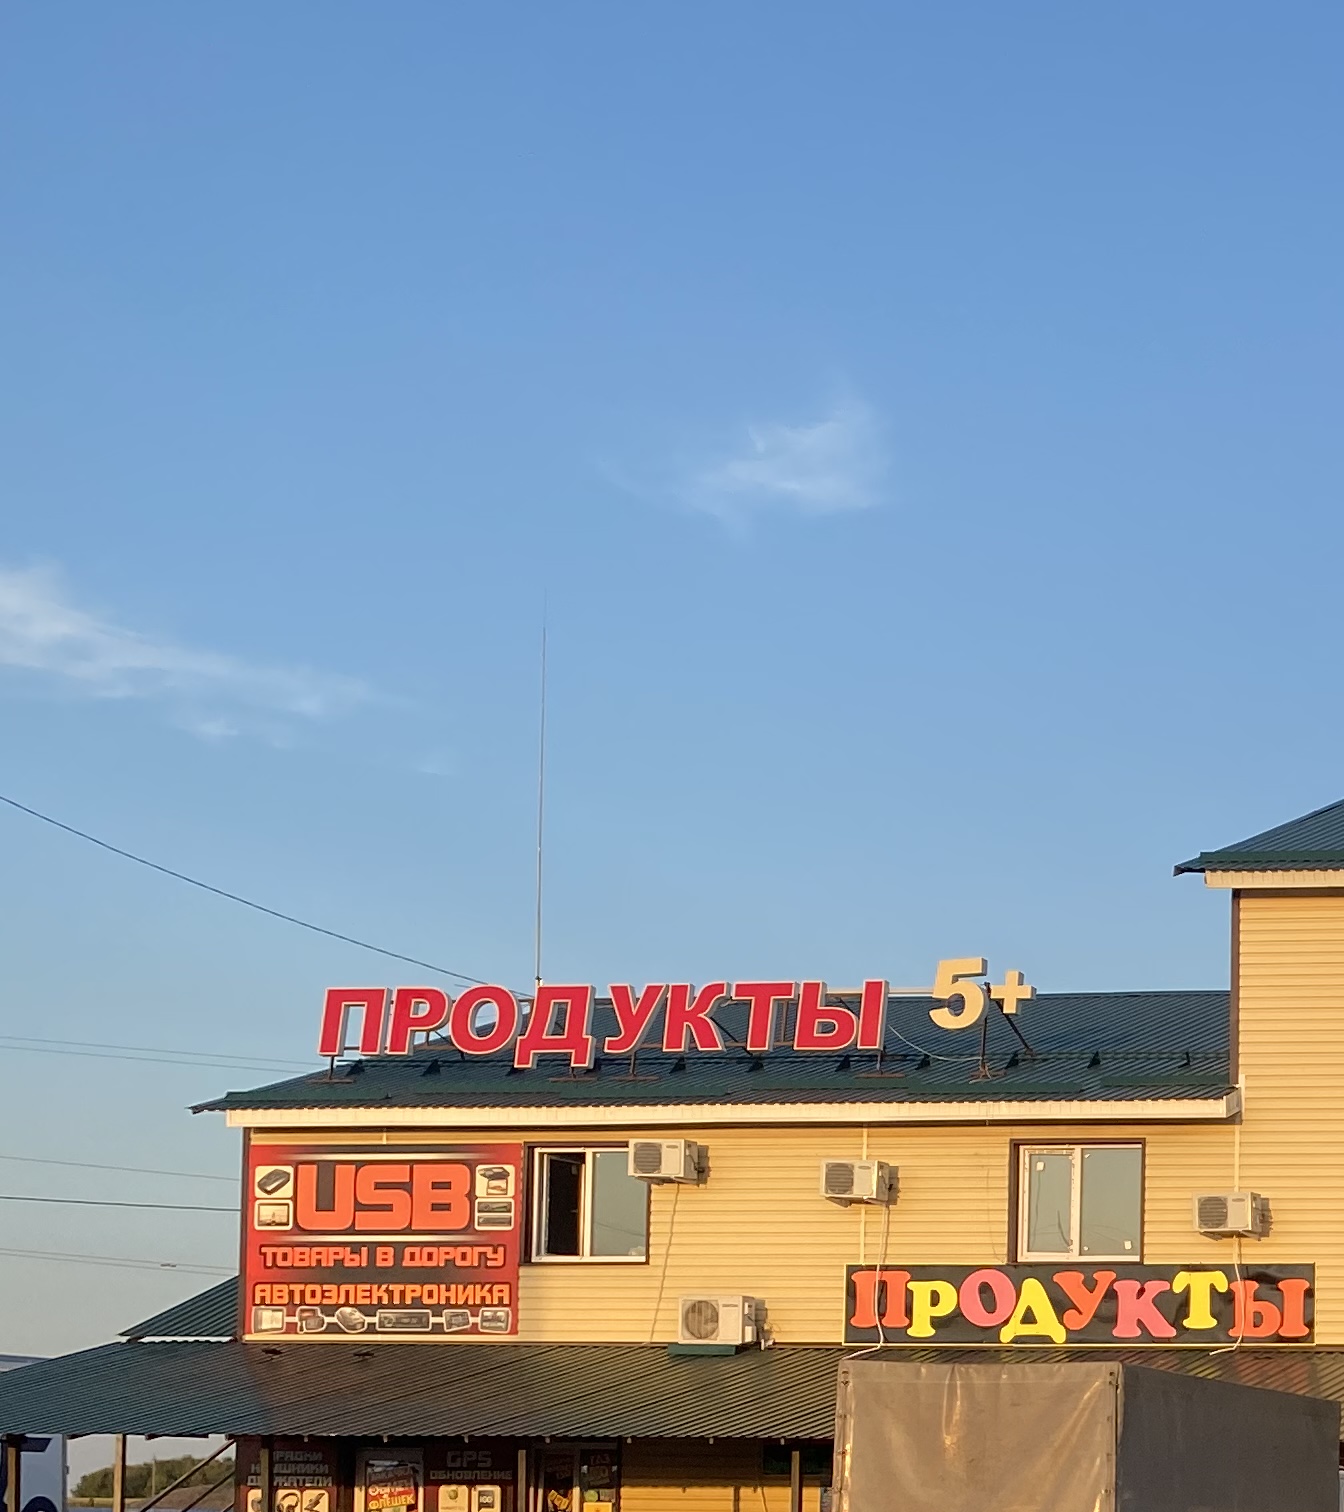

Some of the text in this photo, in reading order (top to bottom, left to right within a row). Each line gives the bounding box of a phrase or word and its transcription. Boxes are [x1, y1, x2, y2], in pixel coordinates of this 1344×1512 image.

[928, 956, 1036, 1030] 5+
[318, 979, 889, 1069] ПРОДУКТЫ
[296, 1163, 471, 1231] USB
[260, 1244, 505, 1268] ТОВАРЫ В ДОРОГУ
[253, 1282, 511, 1306] АВТОЭЛЕКТРОНИКА
[849, 1269, 1311, 1344] ПРОДУКТЫ
[272, 1451, 323, 1462] РЯДКИ
[446, 1450, 492, 1467] GPS
[247, 1475, 333, 1487] ДЖАТЕЛИ
[250, 1463, 329, 1475] НУШНИКИ
